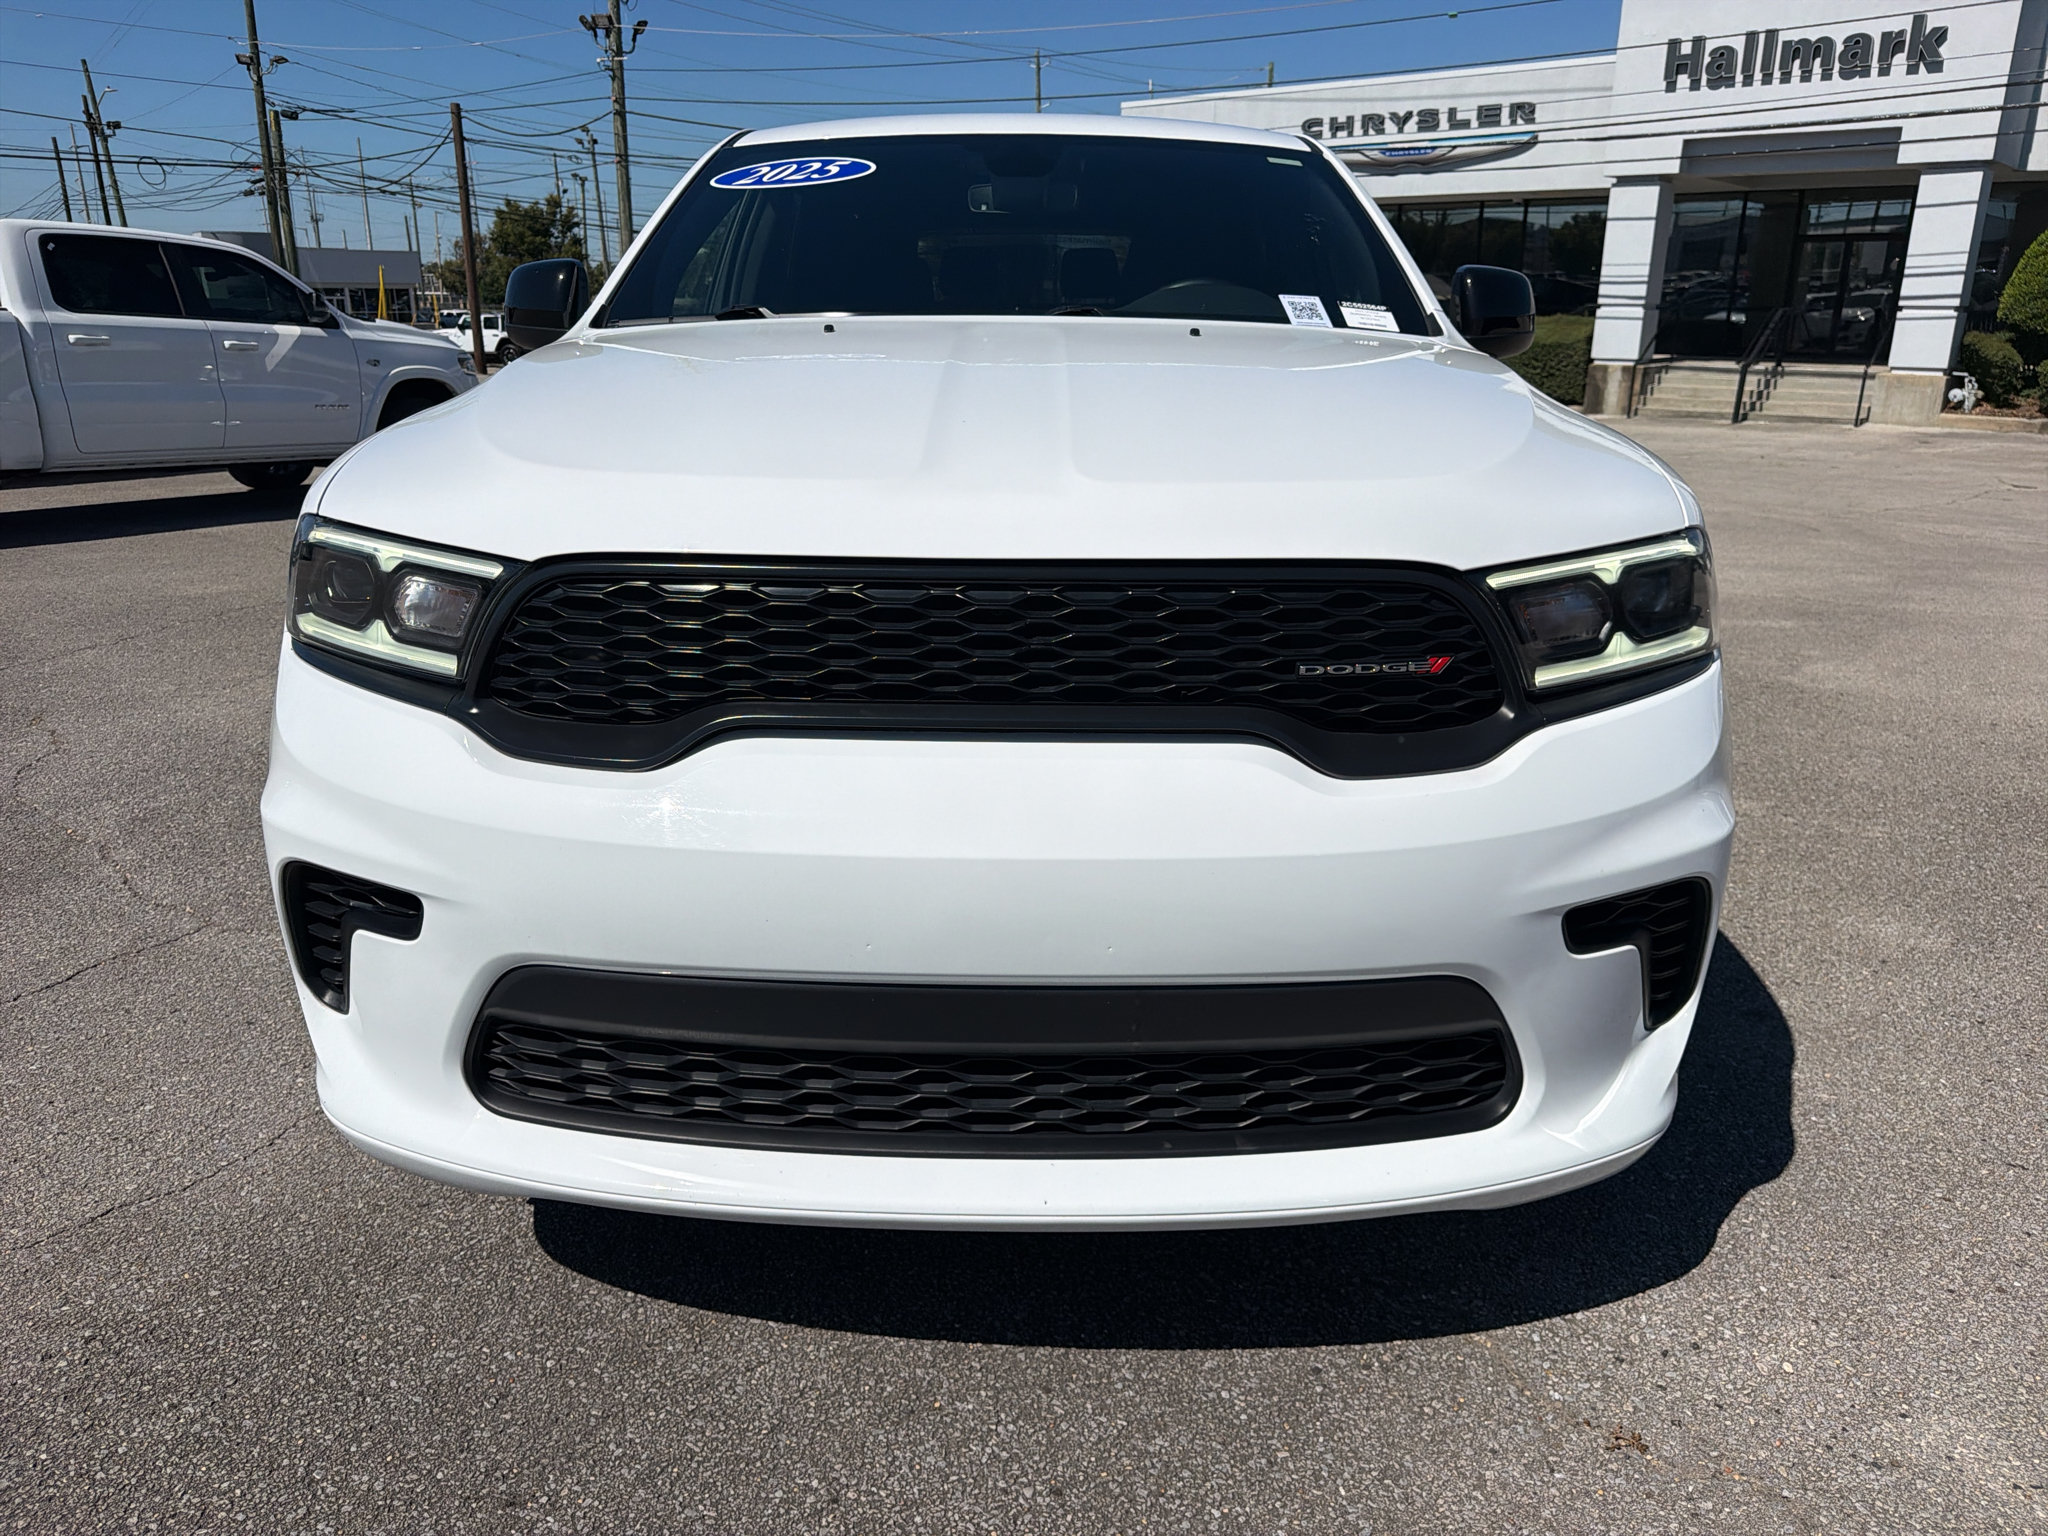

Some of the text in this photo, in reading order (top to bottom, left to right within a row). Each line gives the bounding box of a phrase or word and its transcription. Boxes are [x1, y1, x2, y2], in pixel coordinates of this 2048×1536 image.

[1663, 14, 1949, 92] Hallmark
[1301, 102, 1537, 139] CHRYSLER
[731, 160, 852, 185] 2025
[1299, 661, 1433, 676] DODGE
